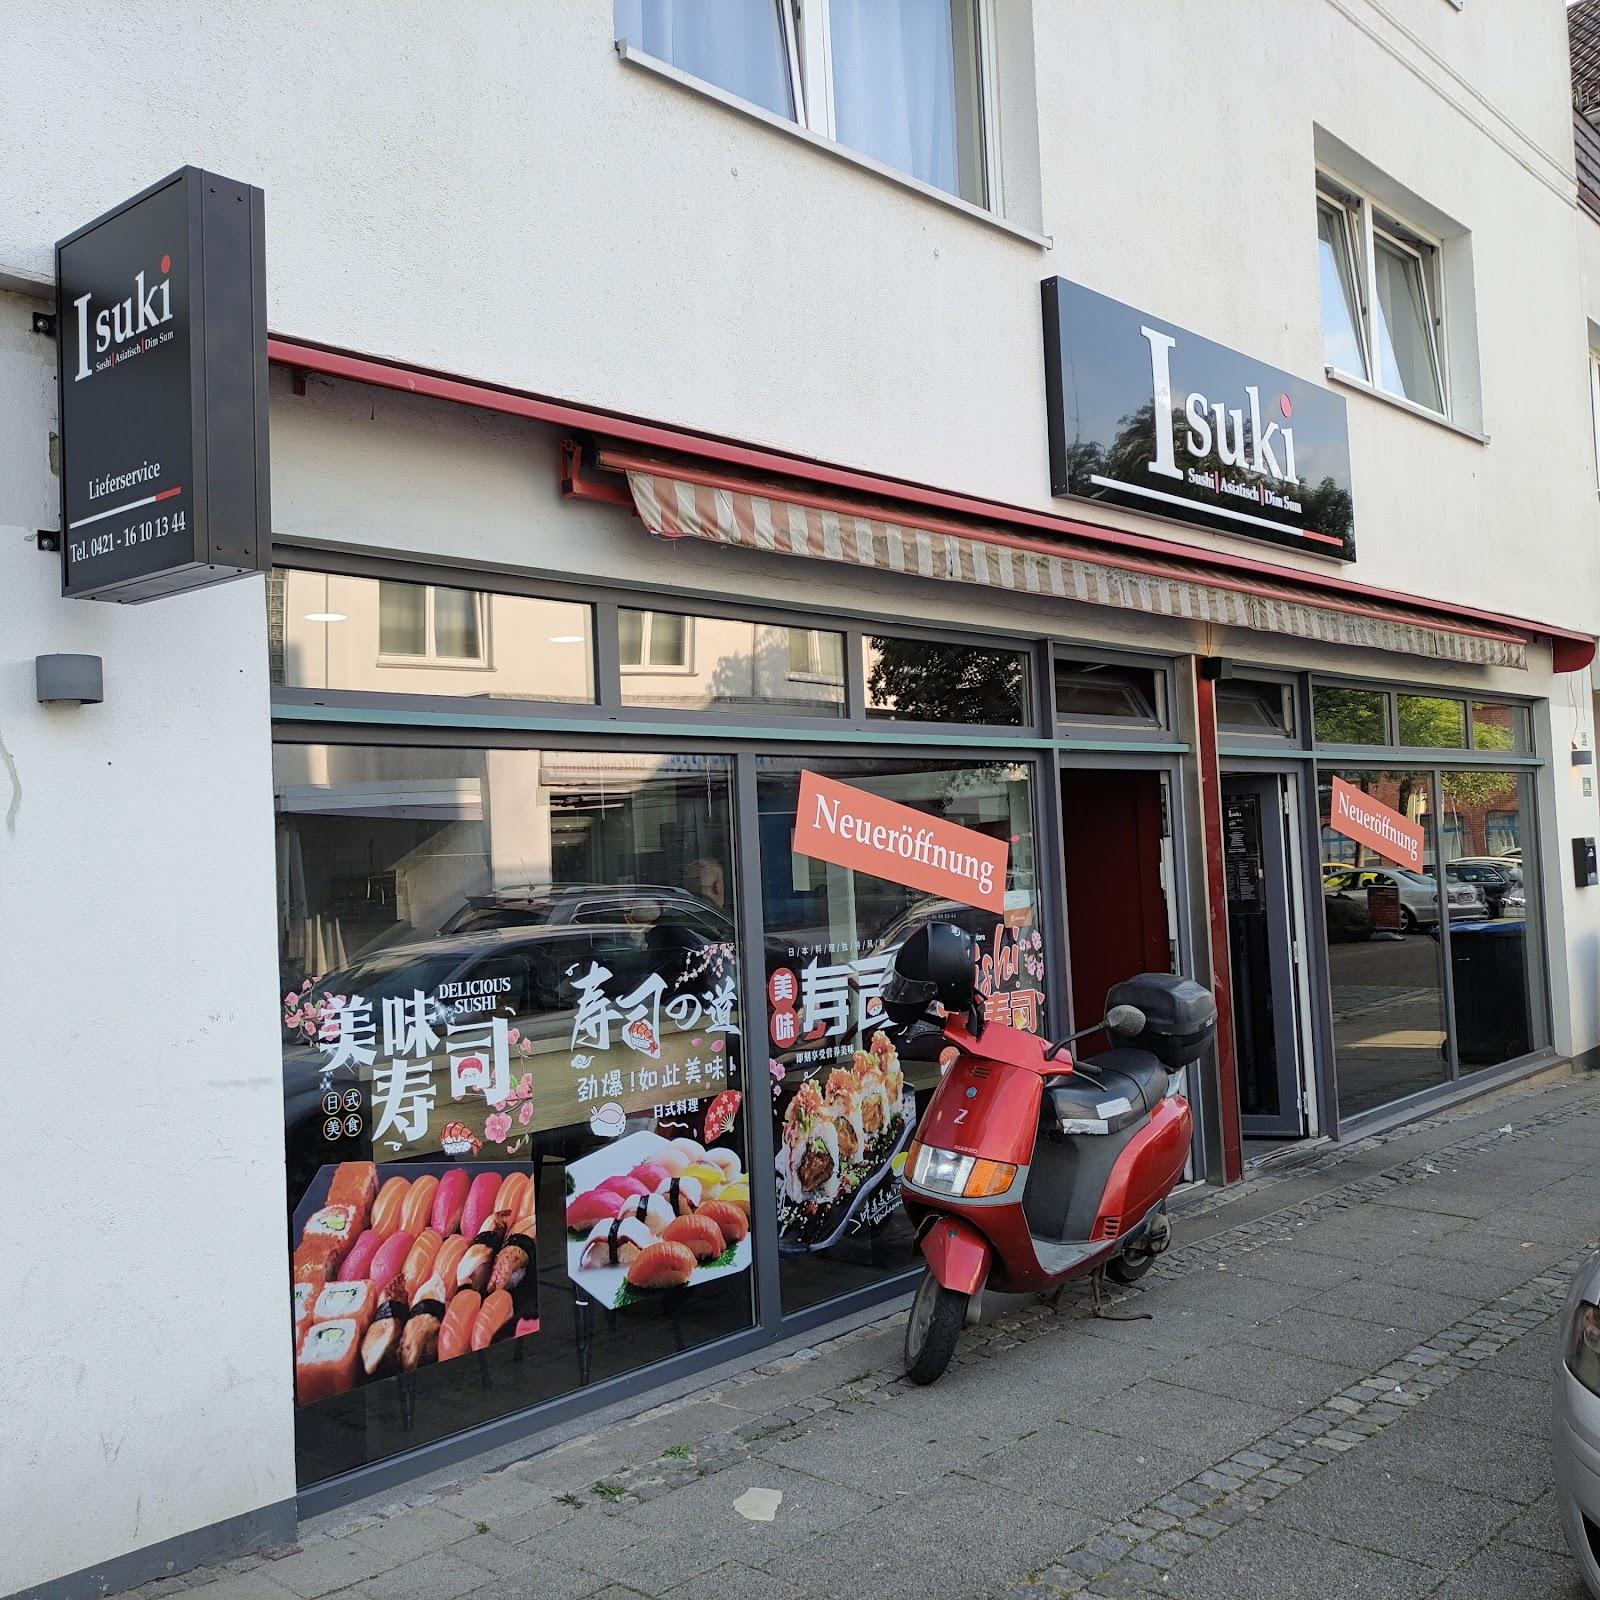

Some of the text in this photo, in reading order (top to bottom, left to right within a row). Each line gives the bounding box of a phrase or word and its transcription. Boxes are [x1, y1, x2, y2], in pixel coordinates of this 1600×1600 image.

[74, 254, 174, 382] Isuki
[95, 329, 174, 373] Sushi Asiatisch Dim Sum
[1140, 325, 1300, 486] Isuki
[88, 460, 161, 500] Lieferservice
[1188, 467, 1303, 514] Sushi Asiatisch Dim Sum
[70, 540, 89, 563] Tel.
[91, 532, 115, 557] 0421
[123, 525, 137, 547] 16
[139, 521, 153, 542] 10
[155, 516, 169, 538] 13
[171, 510, 186, 533] 44
[812, 793, 995, 896] Neueröffnung
[1337, 790, 1418, 862] Neueröffnung
[439, 977, 511, 1000] DELICIOUS
[455, 995, 497, 1014] SUSHI
[570, 960, 742, 1059] 寿司の道
[774, 973, 795, 1041] 美味
[326, 1091, 360, 1112] 日式
[653, 1098, 699, 1119] 日式料理
[326, 1116, 361, 1137] 美食
